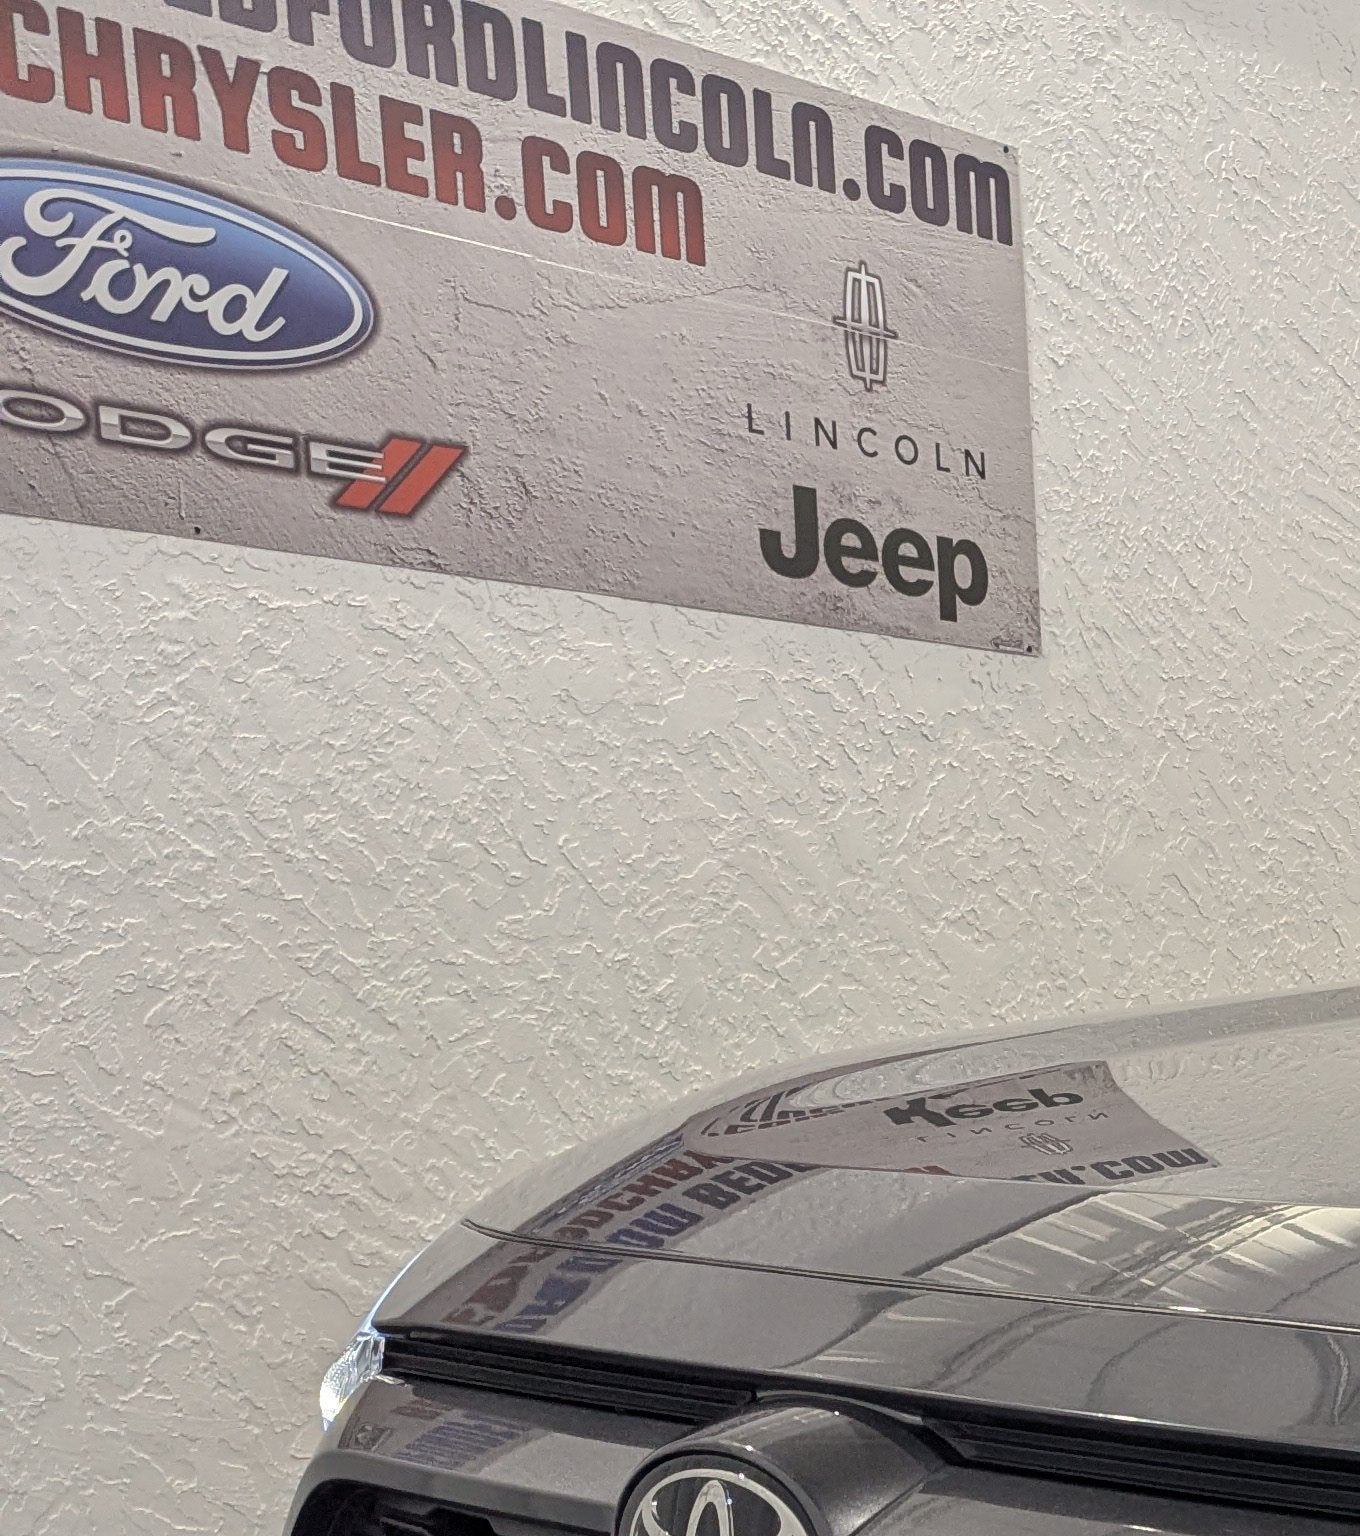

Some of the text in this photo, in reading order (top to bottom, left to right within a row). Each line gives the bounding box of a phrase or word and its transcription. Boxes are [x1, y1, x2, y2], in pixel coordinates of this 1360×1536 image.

[0, 0, 706, 267] CHRYSLER.COM
[0, 188, 290, 342] Ford
[747, 402, 986, 481] LINCOLN
[758, 484, 989, 623] Jeep
